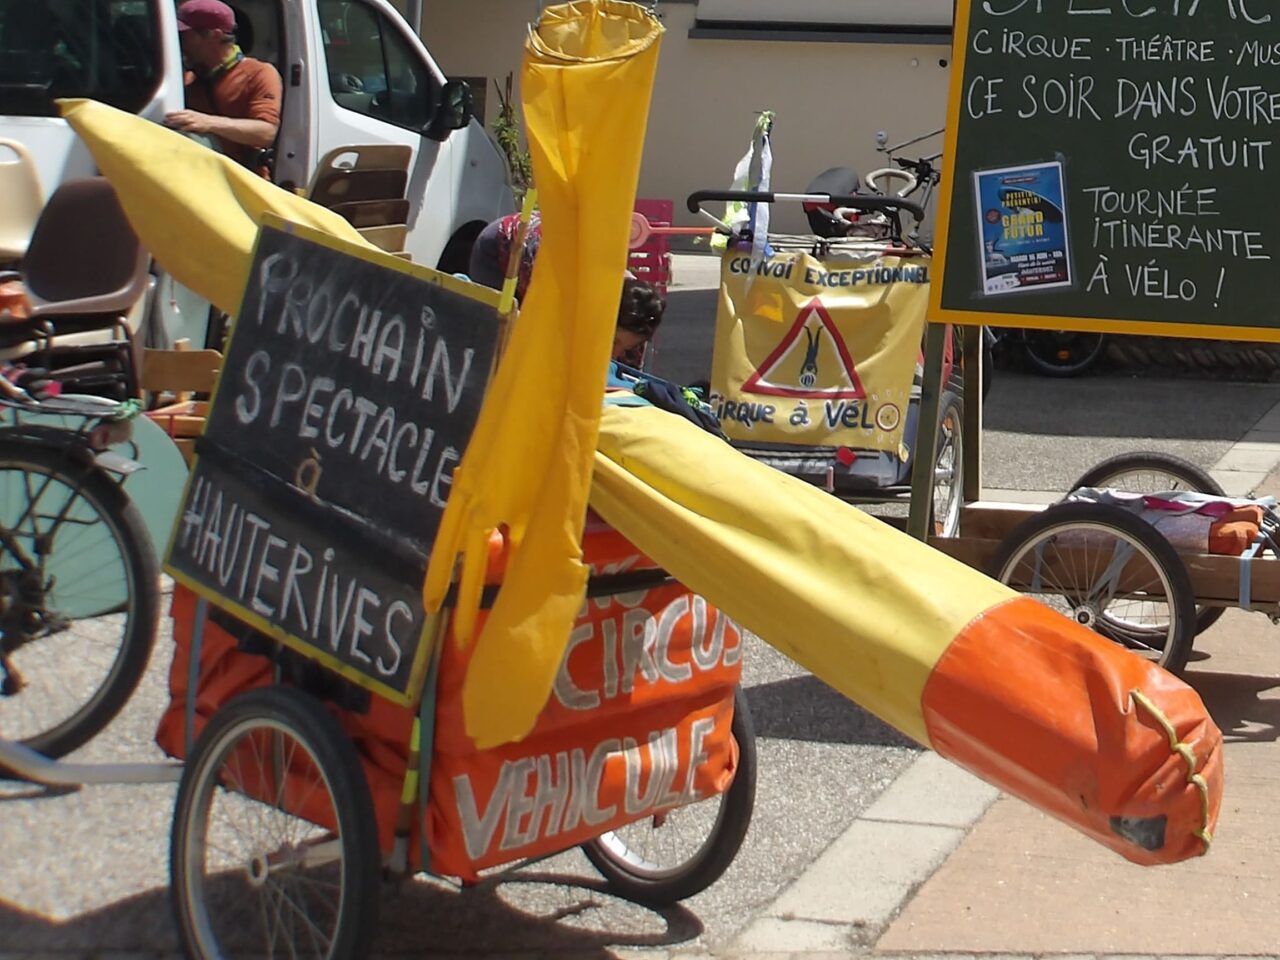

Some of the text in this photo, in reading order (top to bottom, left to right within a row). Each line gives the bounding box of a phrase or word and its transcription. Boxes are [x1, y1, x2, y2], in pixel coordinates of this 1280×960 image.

[973, 28, 1092, 61] CIRQUE
[1116, 35, 1216, 62] THÉÂTRE
[967, 75, 1004, 120] CE
[1018, 73, 1101, 120] SOIR
[1114, 76, 1197, 121] DANS
[1082, 183, 1219, 217] TOURNÉE
[1092, 216, 1271, 260] ITINÉRANTE
[1125, 260, 1197, 301] VÉLO
[256, 251, 476, 414] PROCHAIN
[235, 349, 461, 508] SPECTACLE
[180, 475, 414, 676] HAUTERIVES
[553, 595, 743, 711] CIRCUS
[452, 717, 715, 862] VEHICULE
